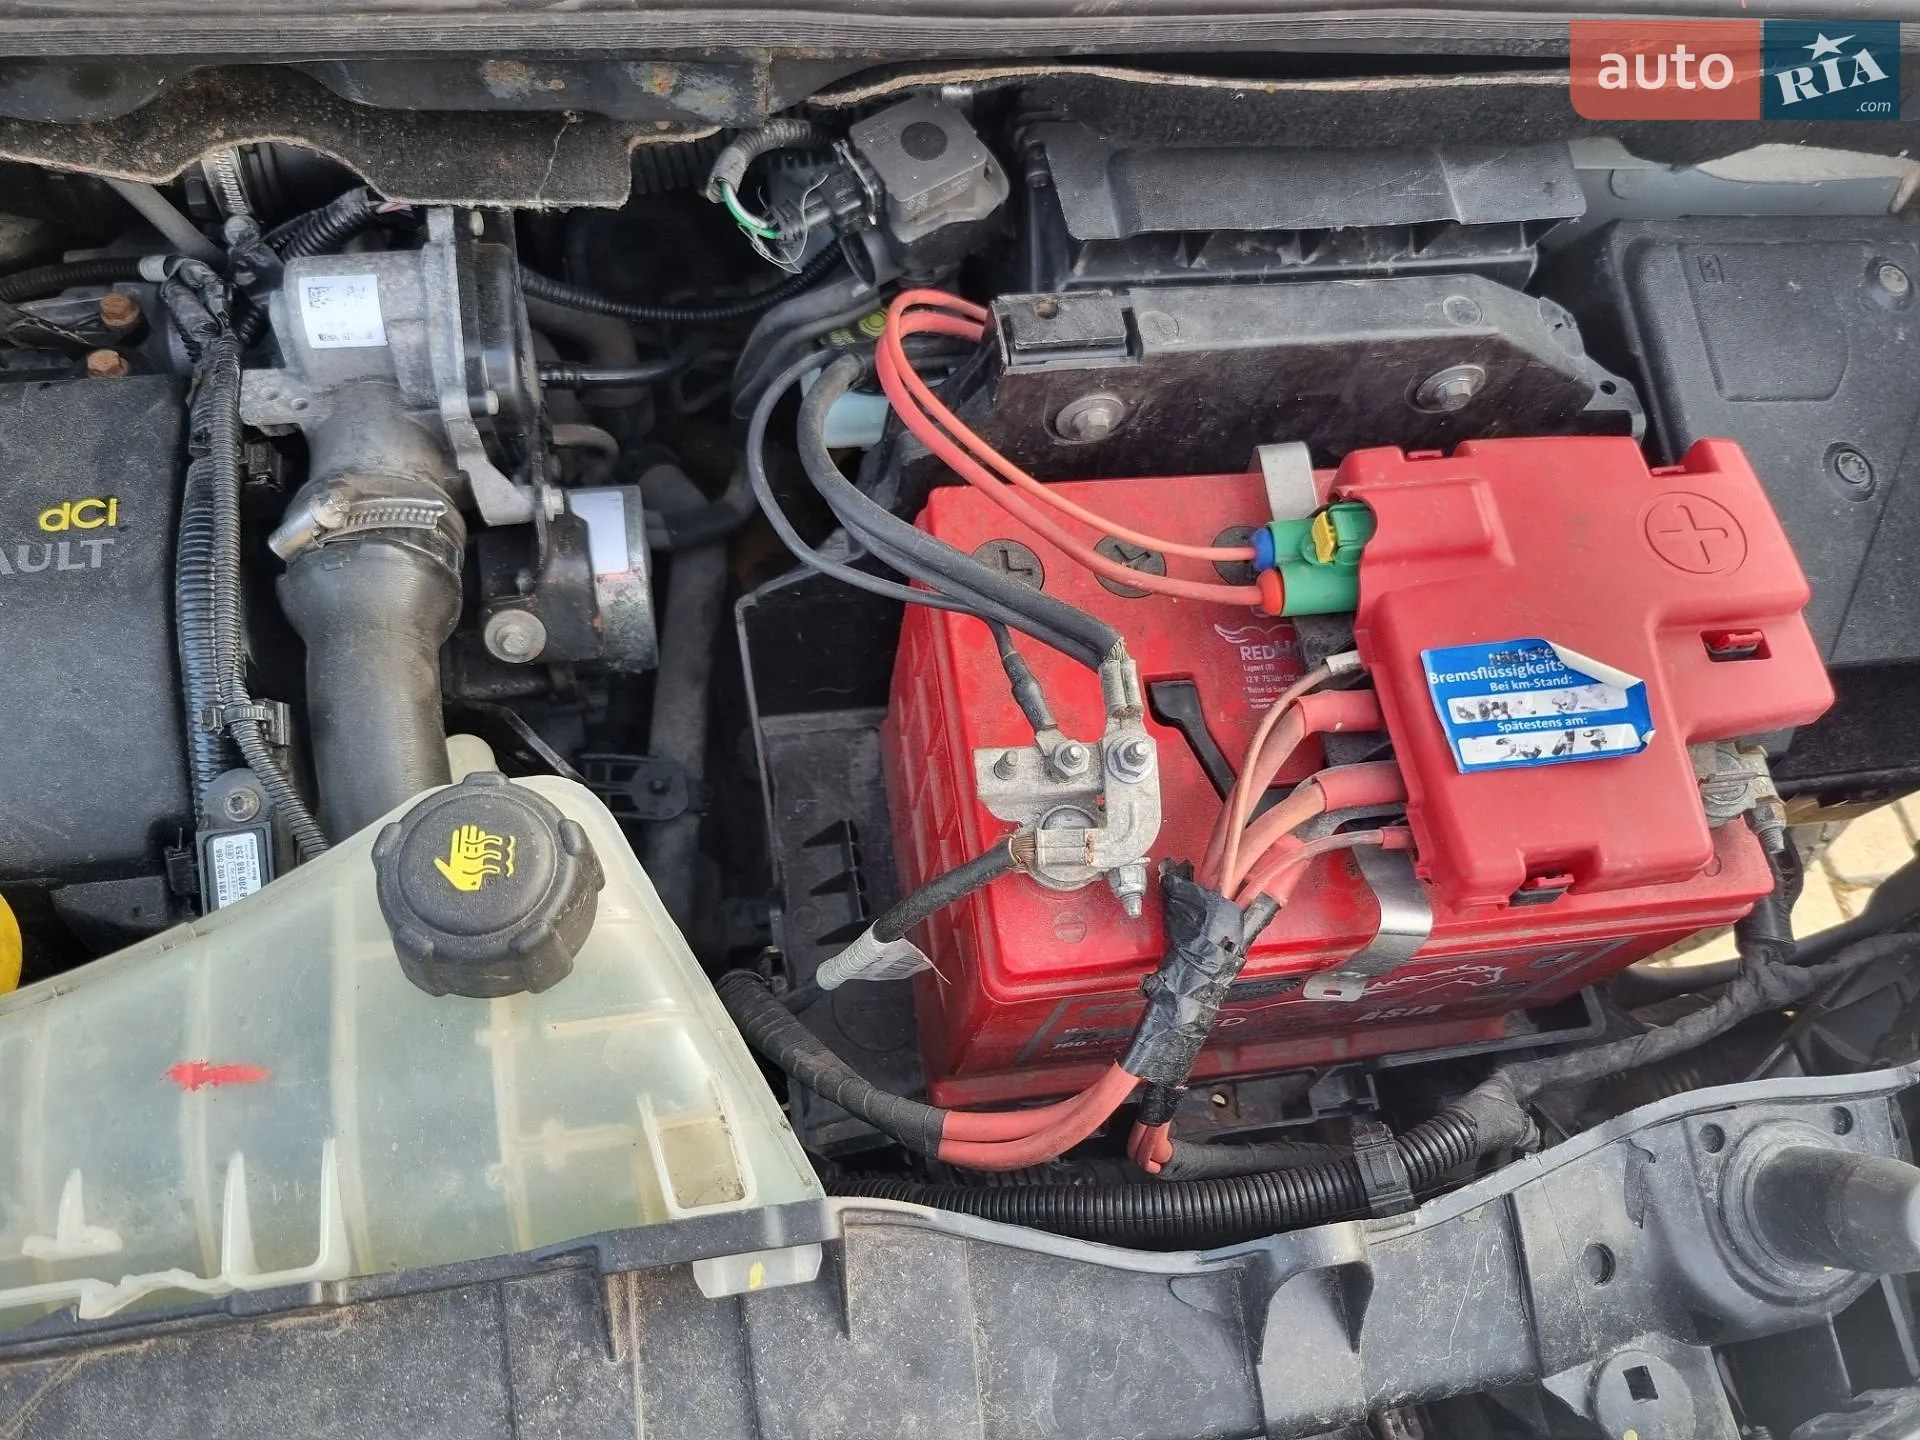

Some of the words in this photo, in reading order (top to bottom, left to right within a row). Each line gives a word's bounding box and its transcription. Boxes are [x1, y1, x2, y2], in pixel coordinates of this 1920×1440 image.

[39, 497, 118, 532] dCi
[1490, 680, 1509, 692] Bei
[1511, 675, 1574, 690] km-Stand:
[1496, 718, 1564, 732] Spätestens
[1565, 716, 1588, 727] am:
